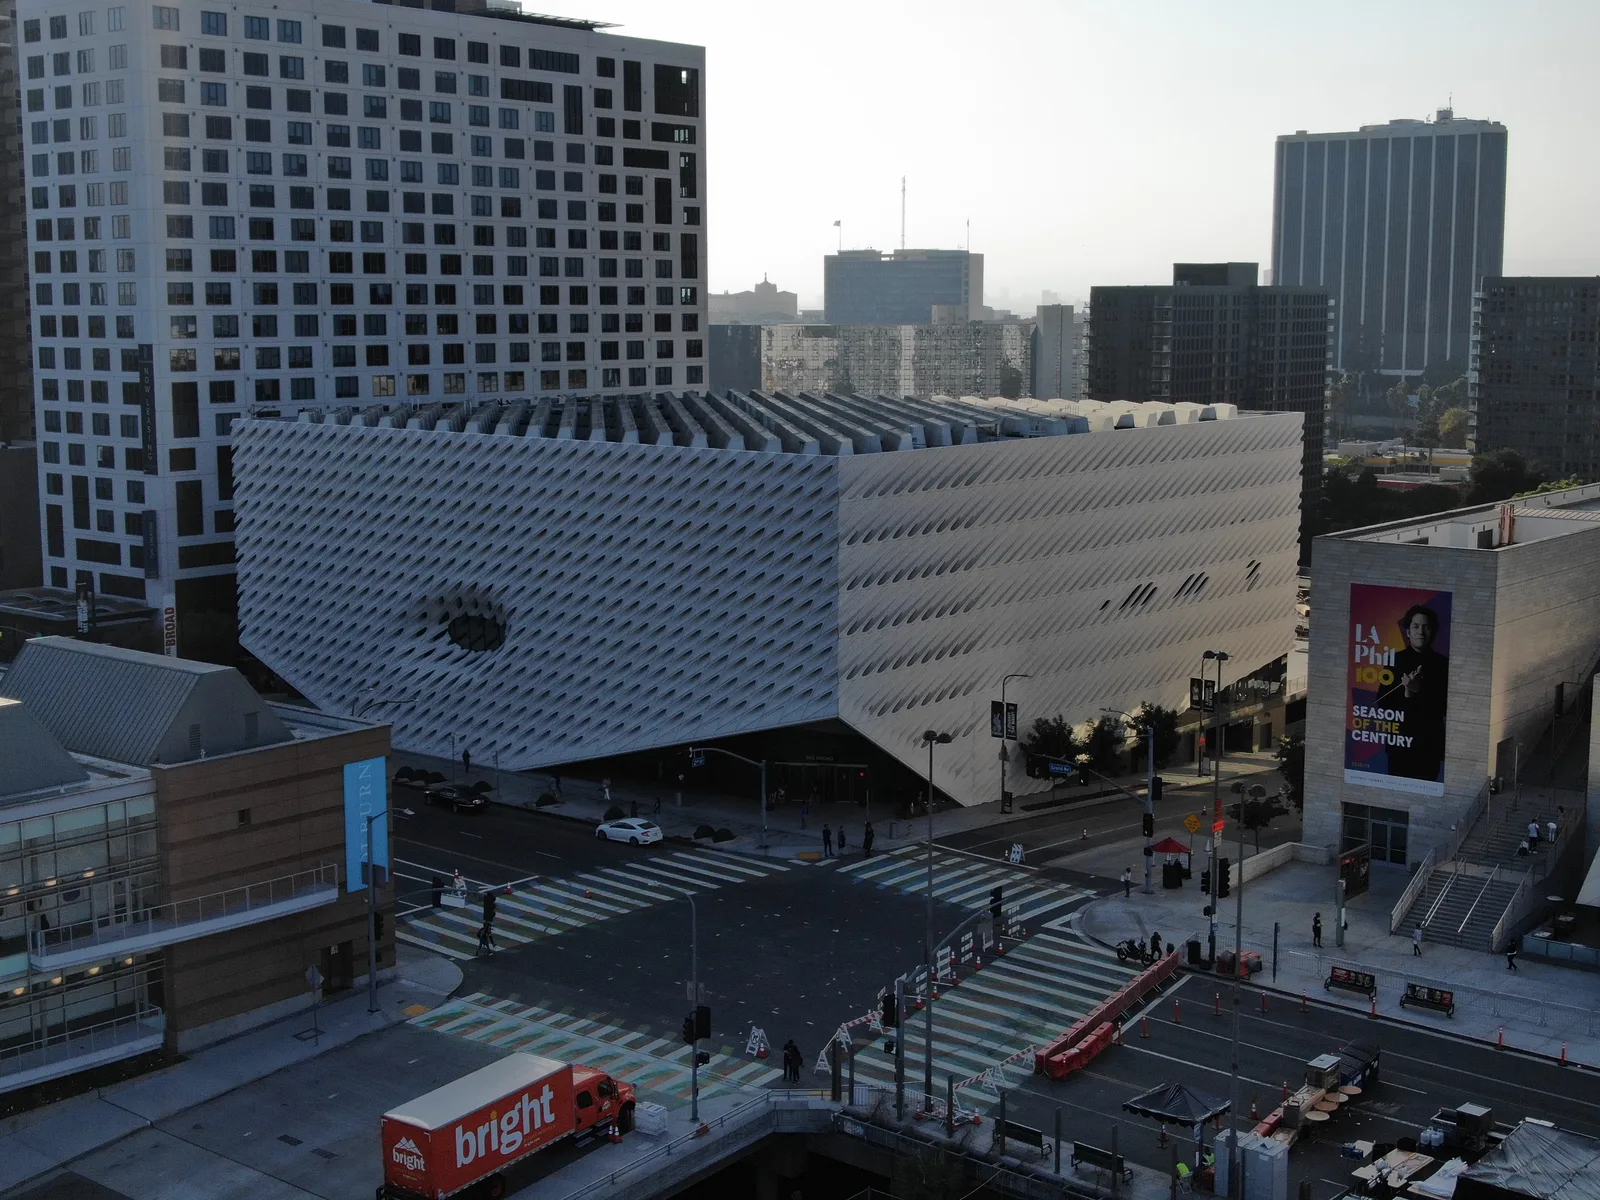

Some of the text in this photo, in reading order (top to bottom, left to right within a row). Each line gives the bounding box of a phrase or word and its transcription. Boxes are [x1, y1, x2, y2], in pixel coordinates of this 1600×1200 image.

[143, 367, 151, 393] NOW
[145, 398, 153, 461] LEASING
[164, 607, 176, 646] BROAD
[1355, 623, 1380, 645] LA
[1354, 644, 1396, 667] Phil
[1355, 667, 1395, 686] 100
[1352, 705, 1405, 722] SEASON
[1351, 718, 1400, 735] OF THE
[1351, 730, 1414, 748] CENTURY
[455, 1083, 556, 1168] bright
[392, 1148, 426, 1171] bright
